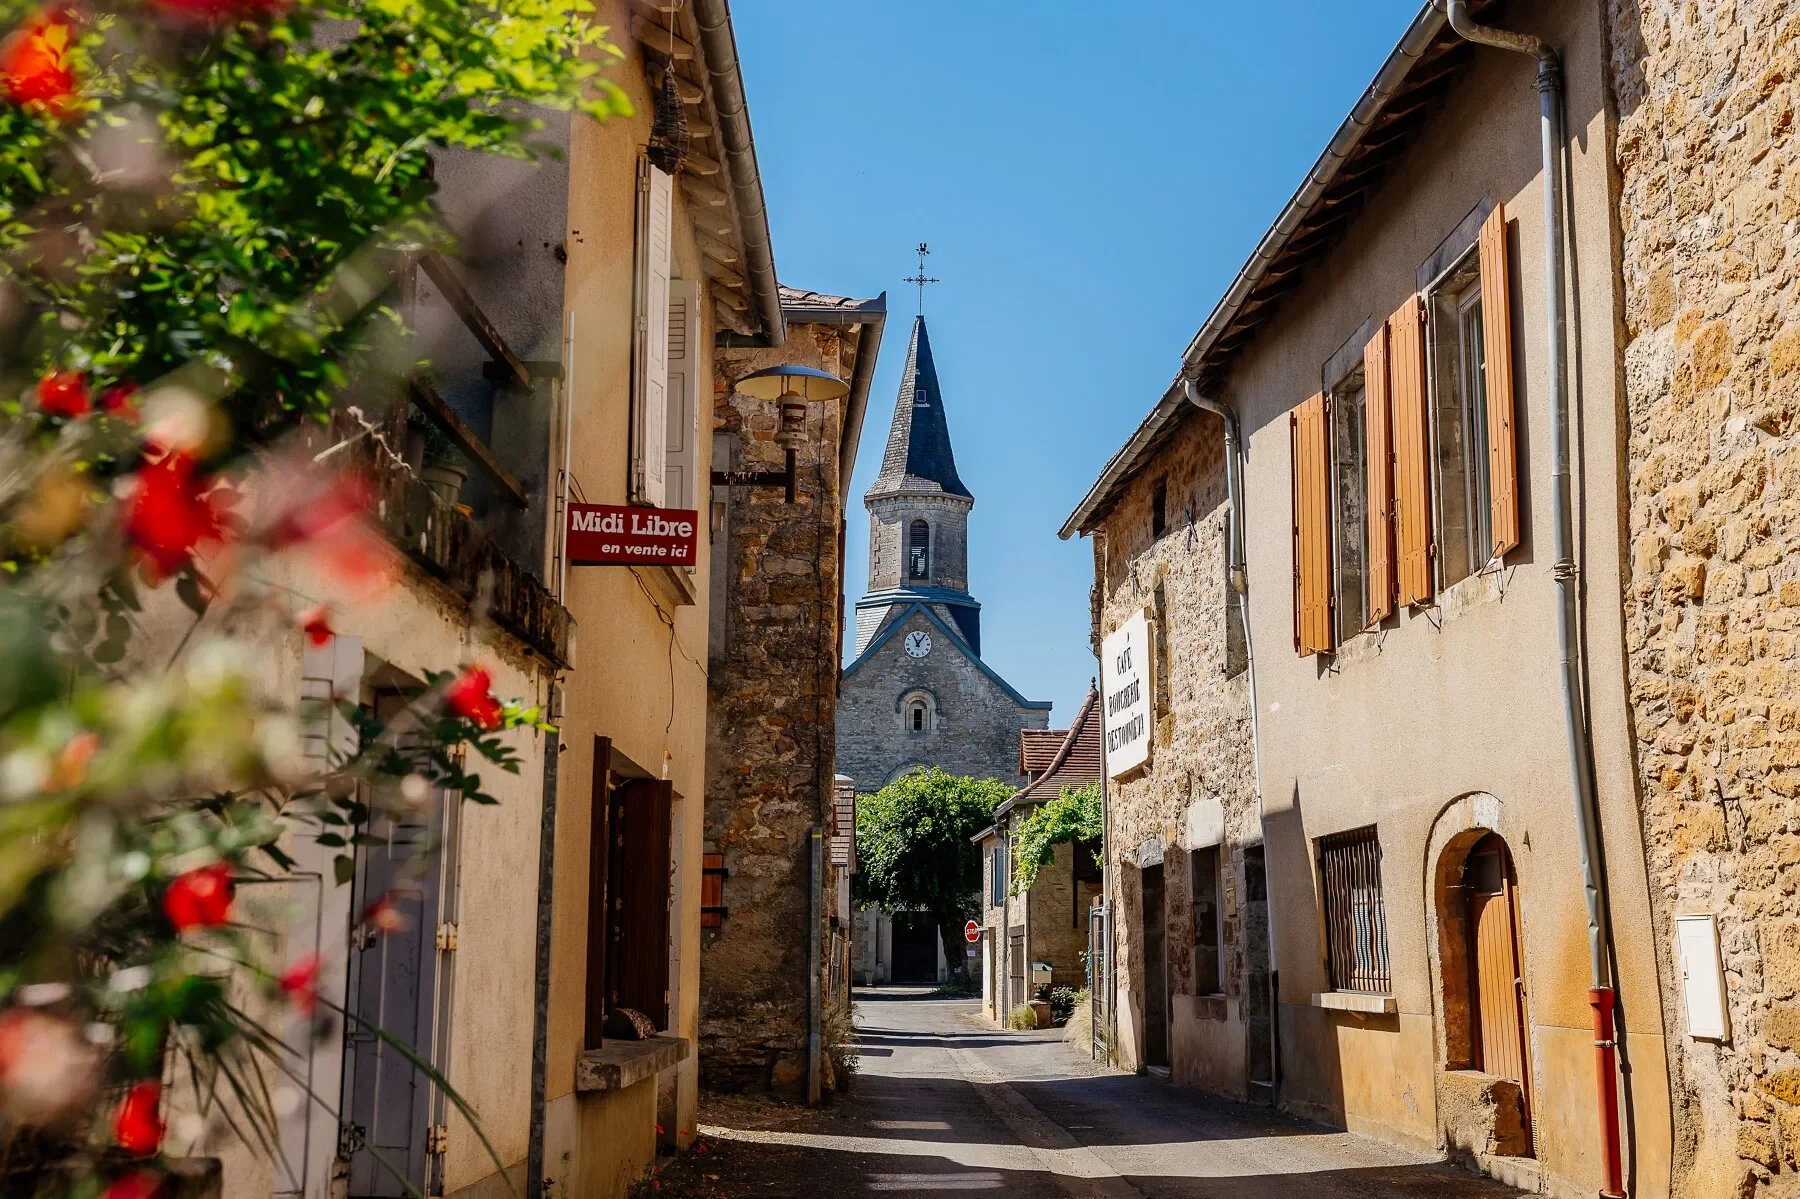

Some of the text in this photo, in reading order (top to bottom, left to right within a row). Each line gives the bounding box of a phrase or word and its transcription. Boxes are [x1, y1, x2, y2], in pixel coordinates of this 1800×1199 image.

[572, 511, 693, 537] Midi Libre
[601, 544, 688, 557] en vente ici
[1117, 632, 1132, 675] CAFÉ
